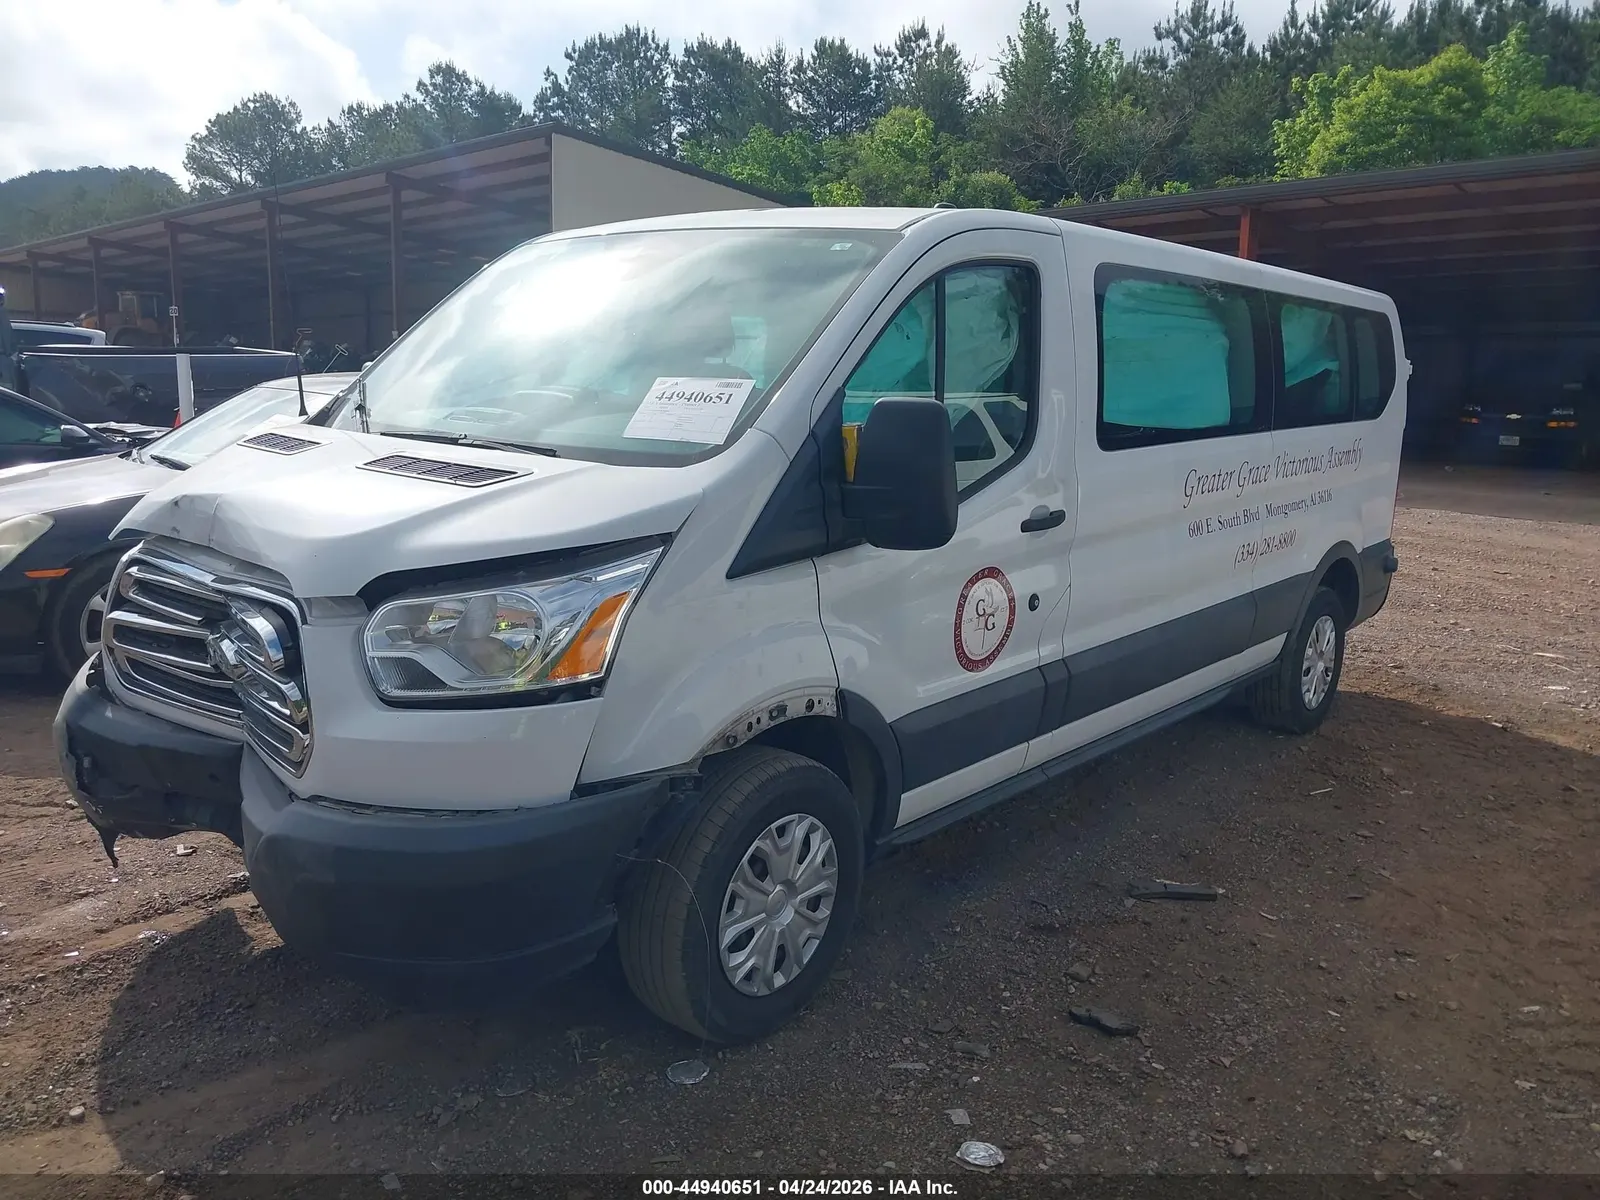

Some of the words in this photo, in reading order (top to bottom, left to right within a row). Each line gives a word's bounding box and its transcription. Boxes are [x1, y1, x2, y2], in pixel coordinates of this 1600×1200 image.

[655, 390, 734, 405] 44940651
[1183, 468, 1236, 509] Greater
[1236, 461, 1271, 498] Grace
[1273, 450, 1325, 479] Victorious
[1322, 437, 1364, 475] Assembly
[1188, 519, 1204, 539] 600
[1206, 518, 1216, 534] E.
[1218, 512, 1242, 531] South
[1243, 506, 1261, 524] Blvd
[1265, 498, 1309, 519] Montgomery,
[1316, 488, 1333, 505] 36116
[1233, 540, 1259, 569] (334)
[1259, 529, 1297, 557] 281-8800
[976, 598, 985, 617] G
[985, 613, 996, 631] G
